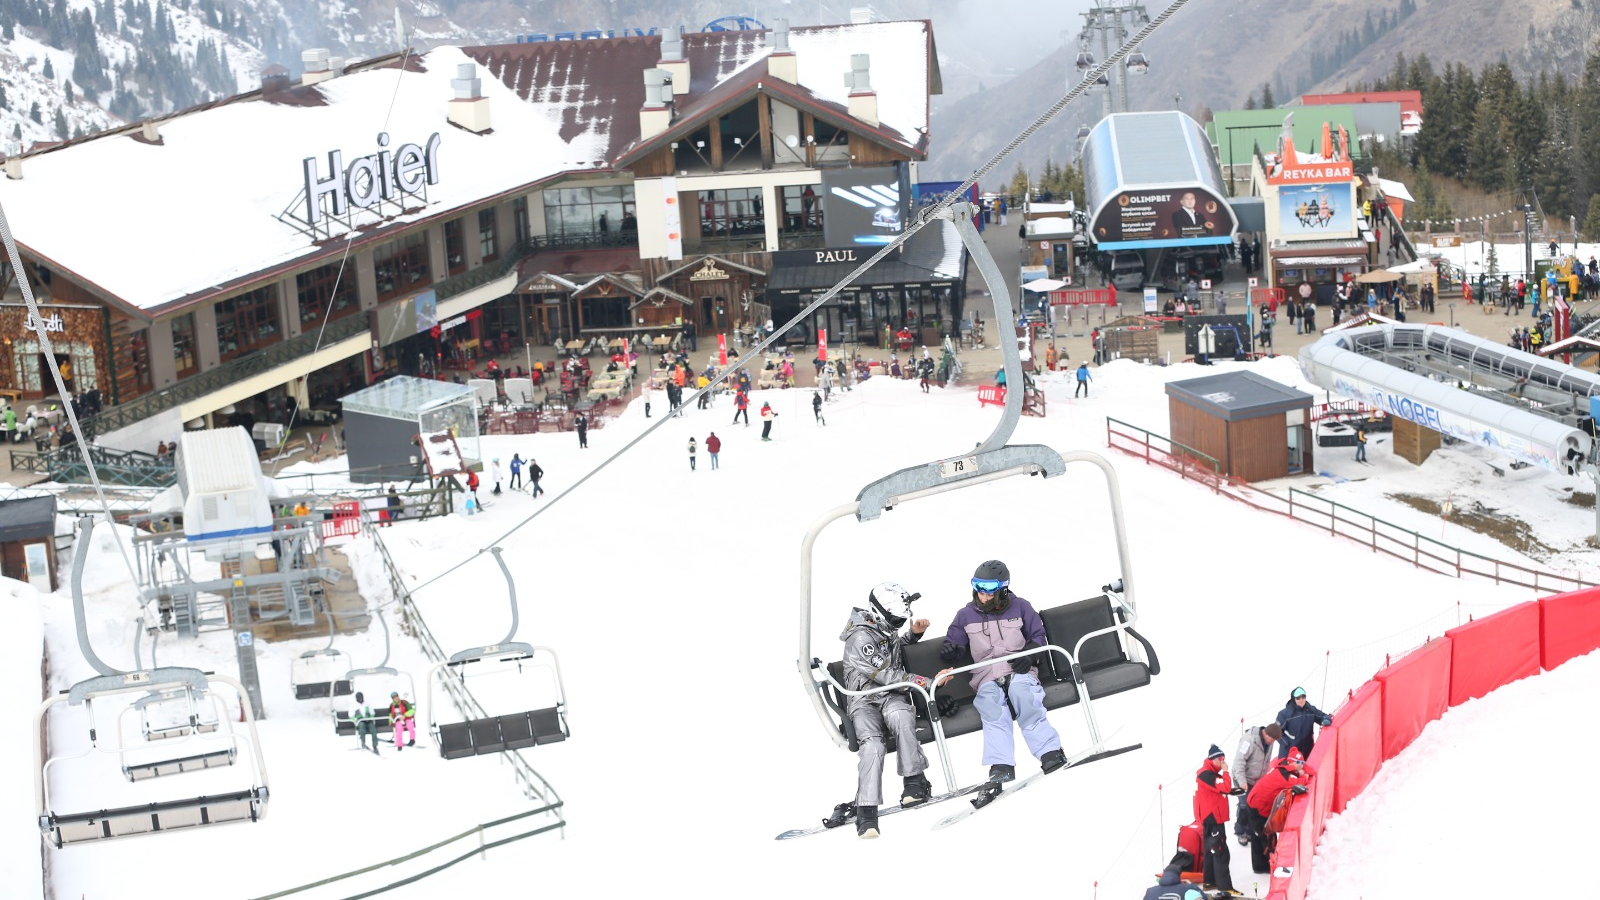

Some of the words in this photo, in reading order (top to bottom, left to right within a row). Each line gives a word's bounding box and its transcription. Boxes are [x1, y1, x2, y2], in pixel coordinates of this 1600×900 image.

[303, 131, 441, 225] Haier
[1283, 168, 1324, 180] REYKA
[1325, 167, 1351, 177] BAR
[1130, 194, 1171, 204] OLIMPBET
[816, 250, 858, 263] PAUL
[1388, 394, 1451, 435] NOBEL
[953, 460, 964, 471] 73
